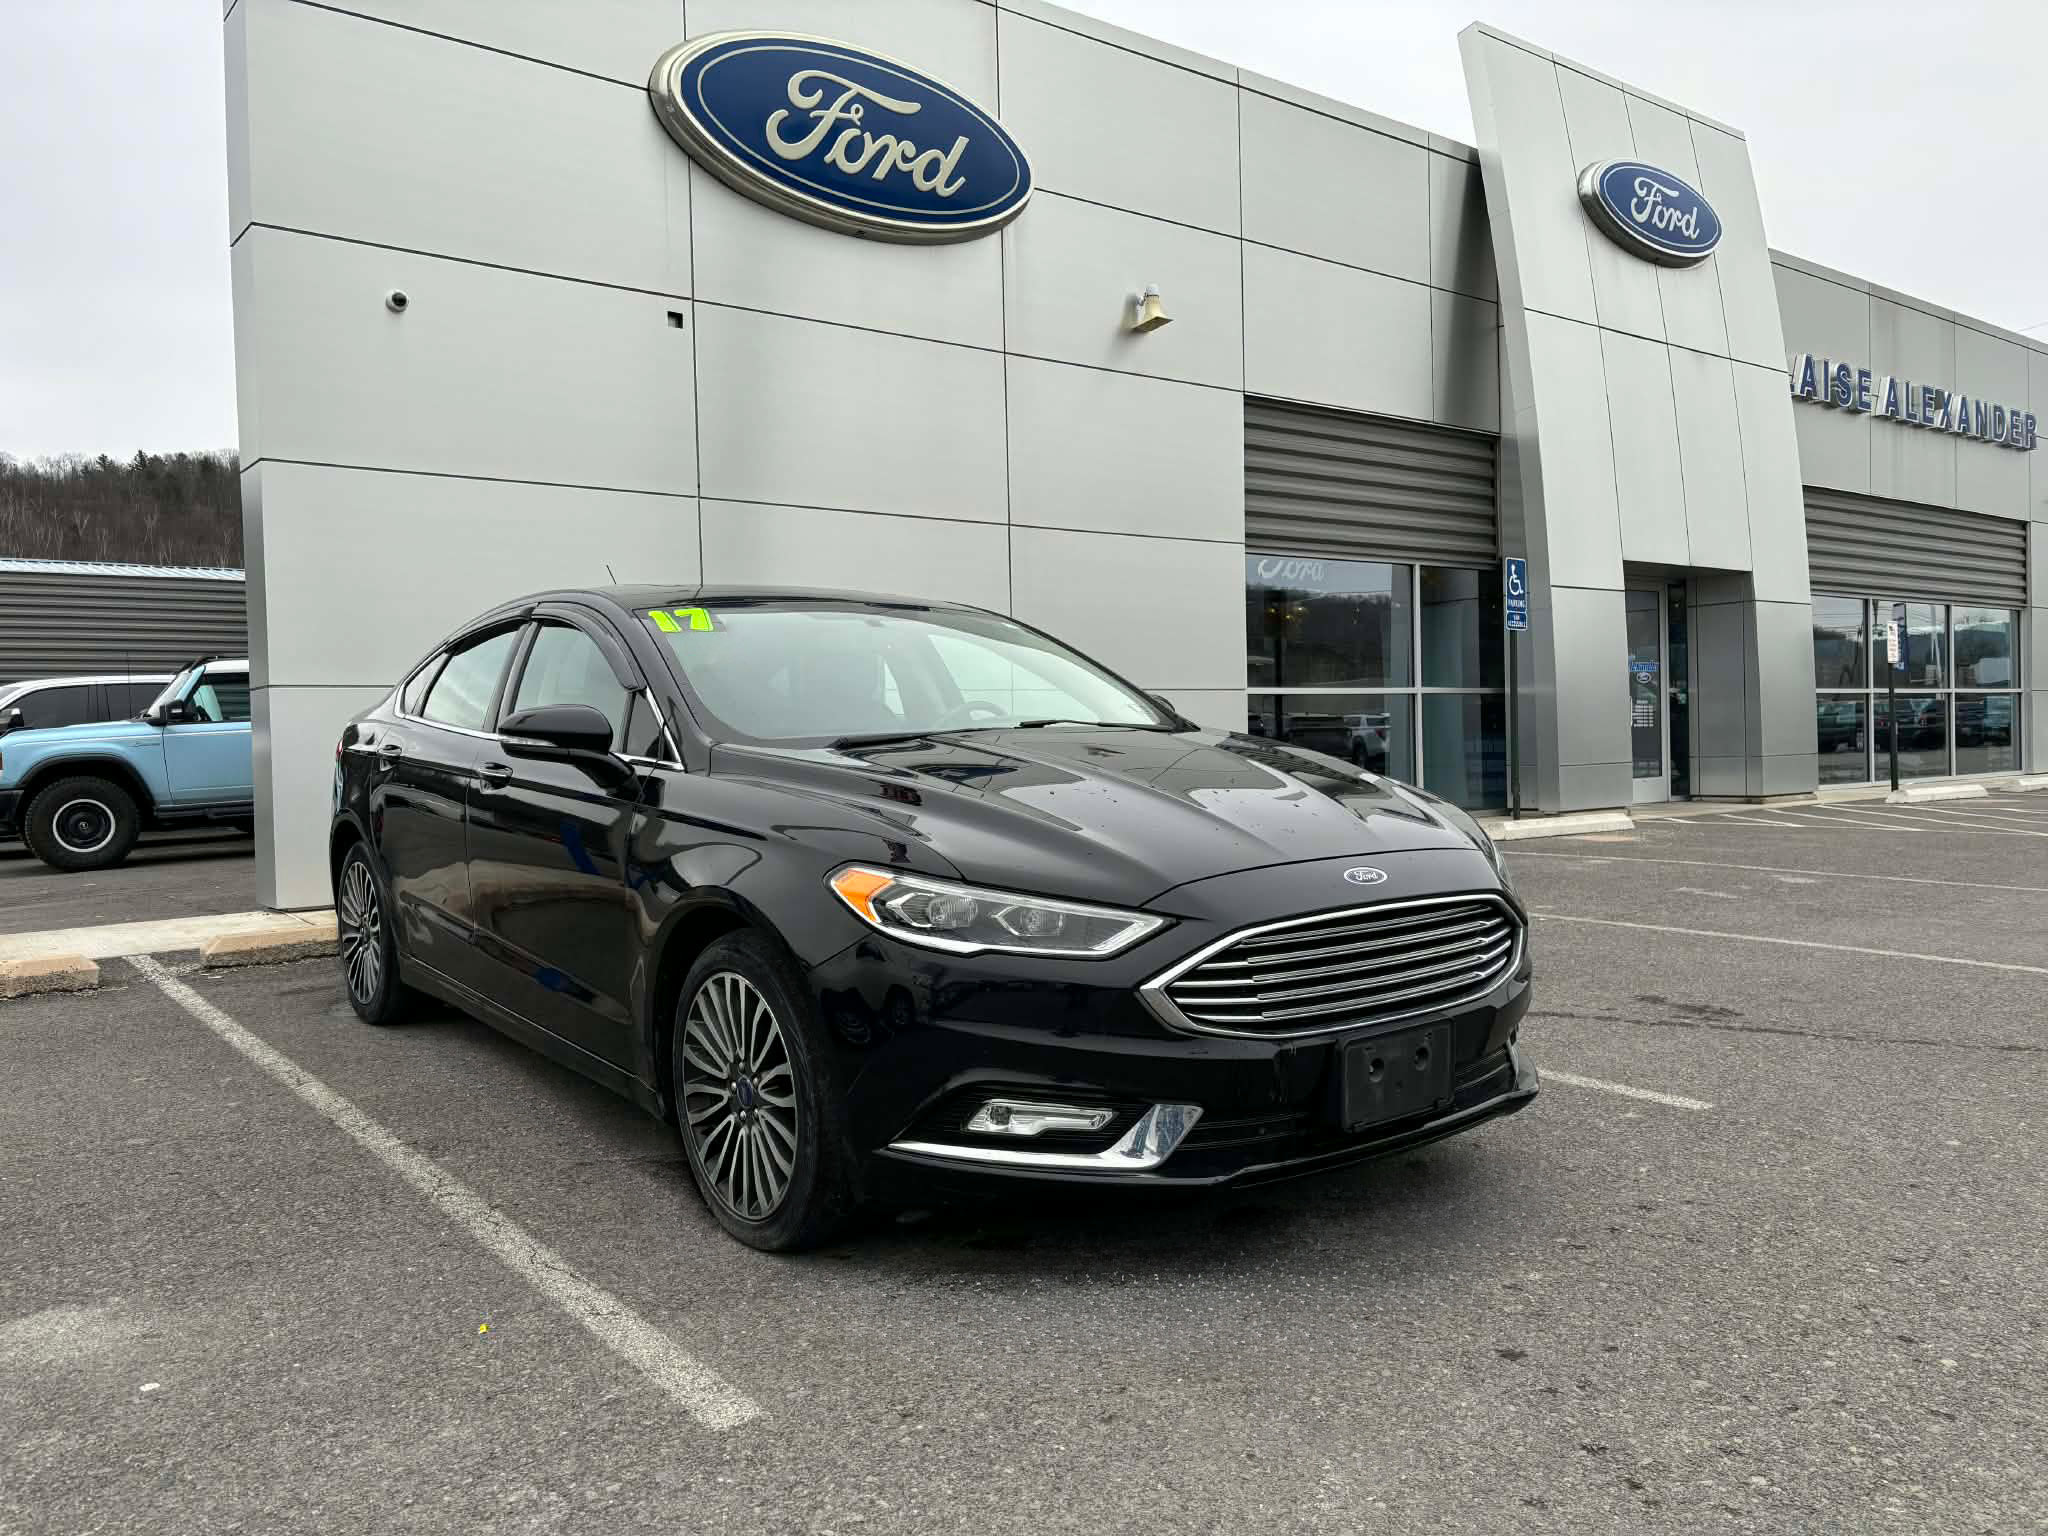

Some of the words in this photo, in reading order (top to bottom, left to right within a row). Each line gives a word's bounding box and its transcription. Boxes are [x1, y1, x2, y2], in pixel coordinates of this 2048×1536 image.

[765, 69, 970, 198] Ford
[1630, 176, 1700, 240] Ford
[1789, 353, 1872, 412] AISE
[1878, 375, 2037, 450] ALEXANDER
[648, 608, 714, 632] 17
[1354, 870, 1378, 881] Ford
